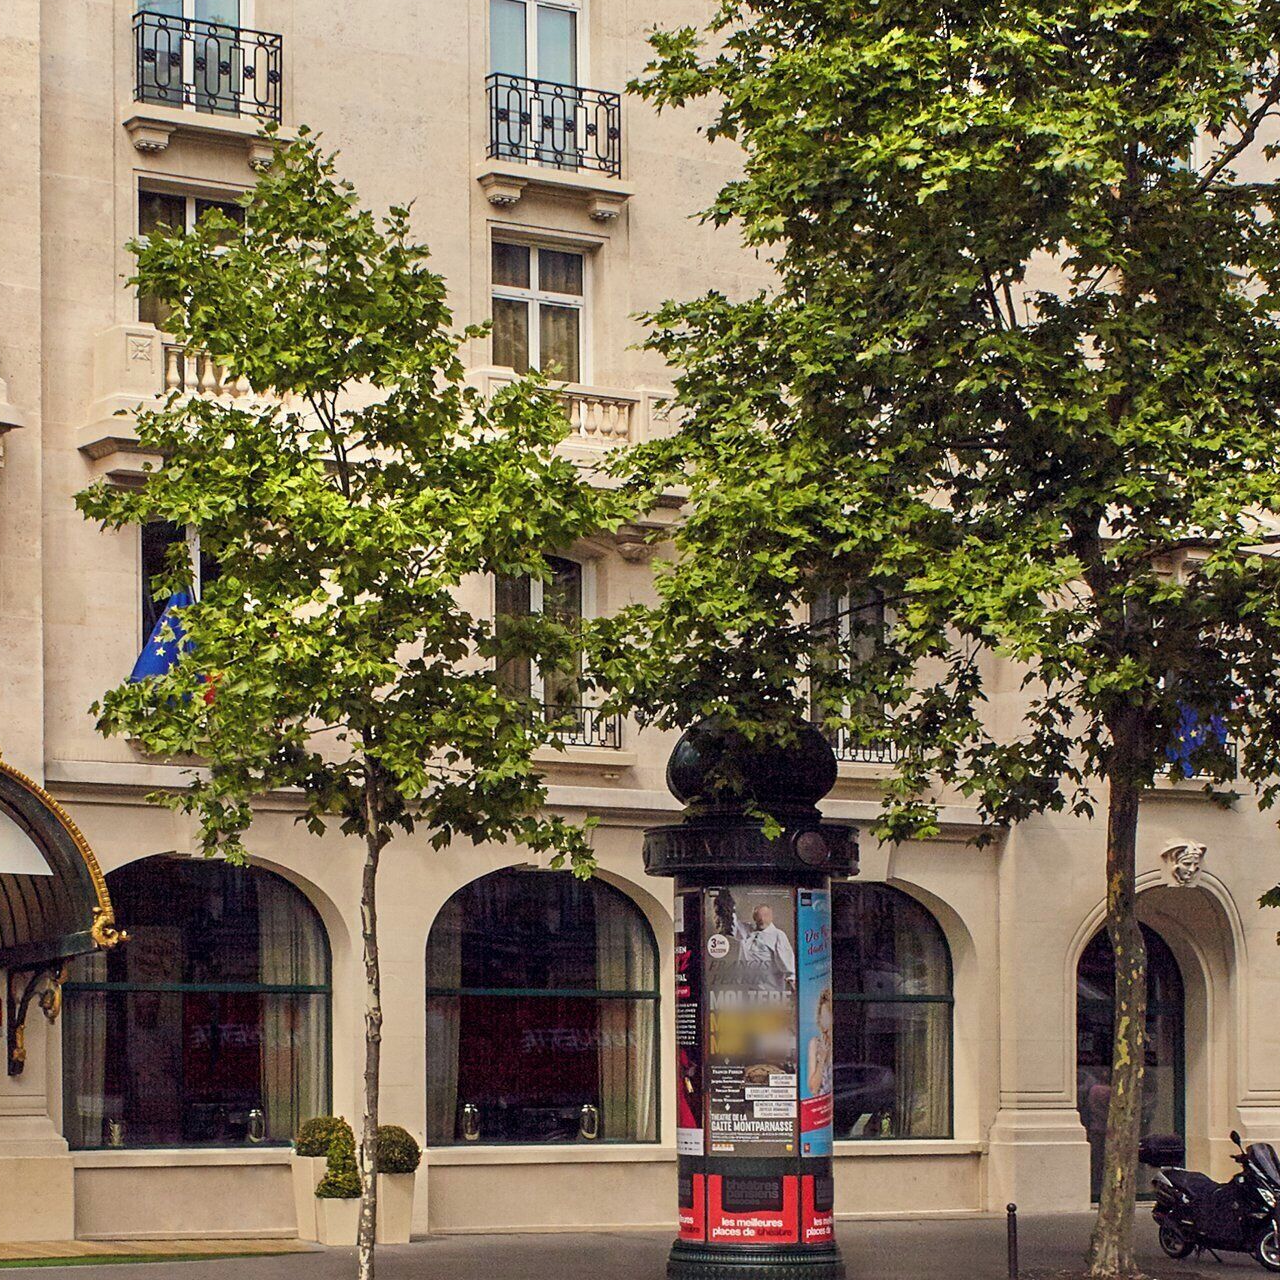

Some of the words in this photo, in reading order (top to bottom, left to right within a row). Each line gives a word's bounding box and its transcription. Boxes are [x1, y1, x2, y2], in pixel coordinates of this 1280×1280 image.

[733, 1121, 794, 1132] MONTPARNASSE
[721, 1217, 735, 1227] les
[736, 1217, 783, 1227] meilleures
[712, 1226, 741, 1238] places
[742, 1227, 756, 1237] de
